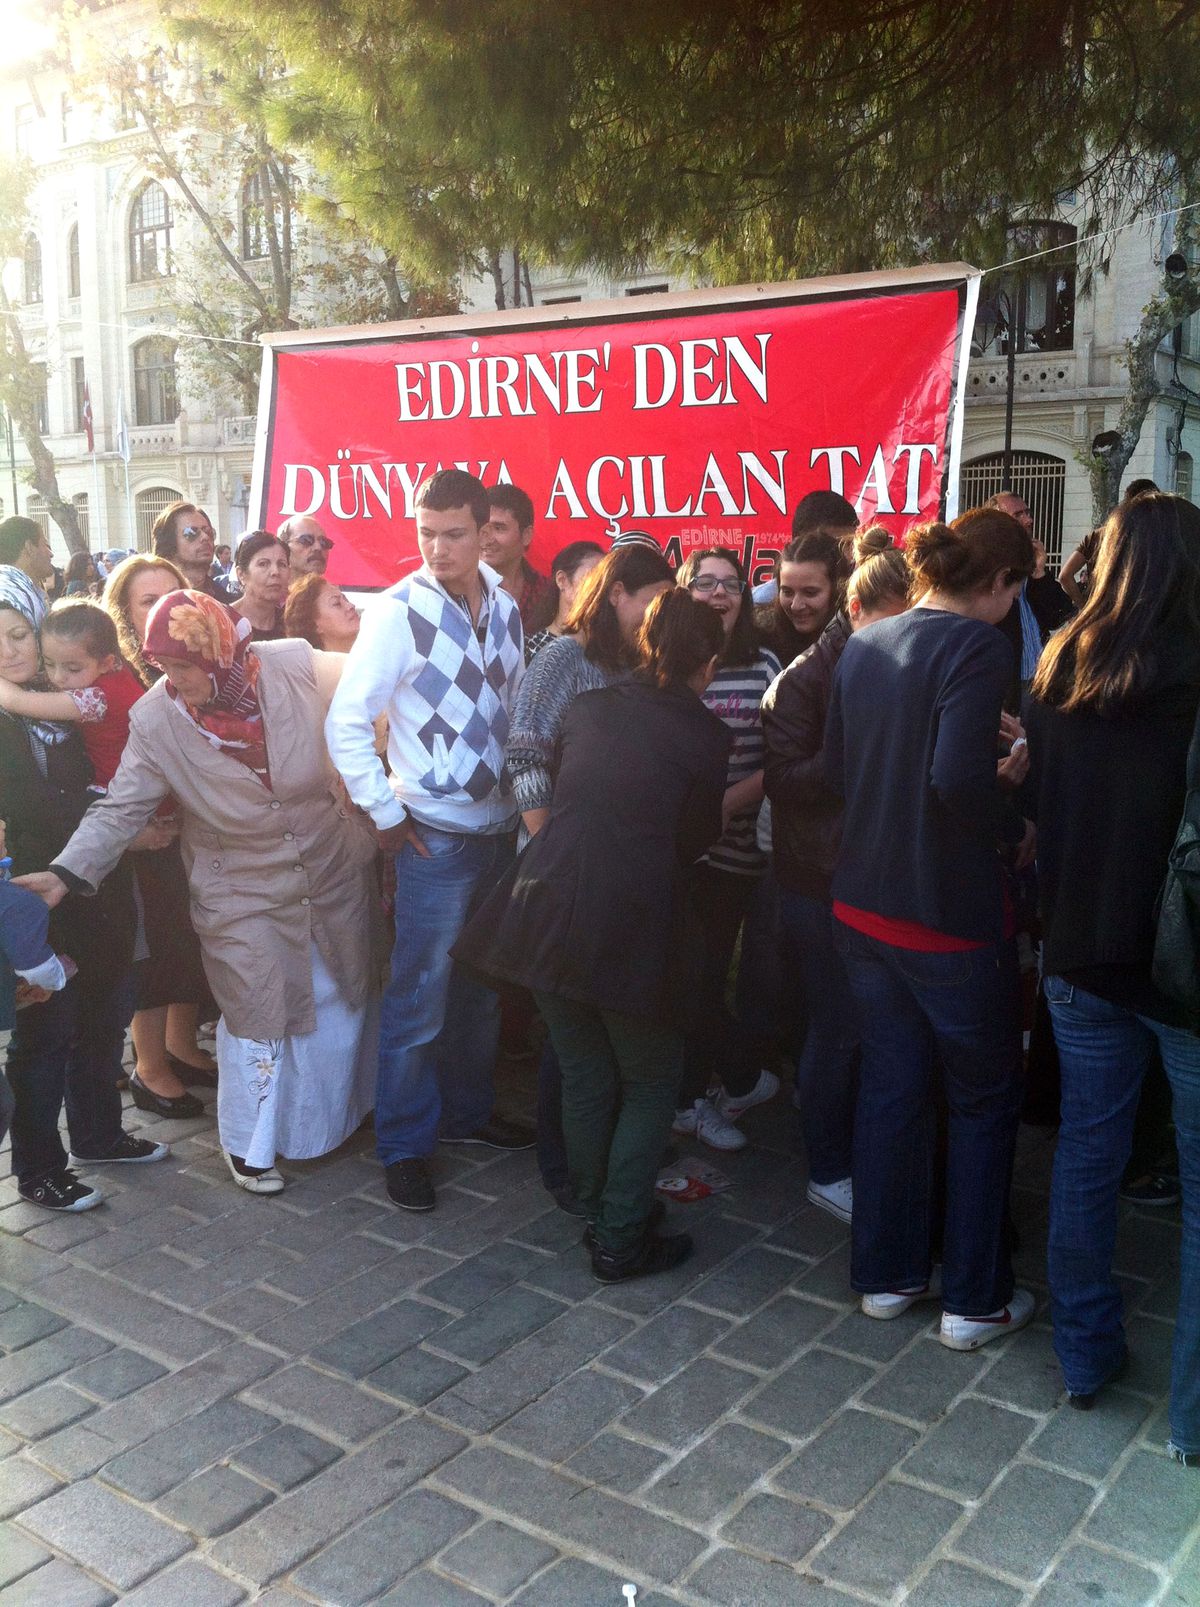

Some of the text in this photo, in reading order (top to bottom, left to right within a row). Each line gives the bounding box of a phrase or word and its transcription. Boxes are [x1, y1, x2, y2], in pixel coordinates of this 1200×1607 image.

[394, 333, 773, 422] EDİRNE' DEN
[544, 451, 789, 538] AÇILAN
[809, 442, 939, 515] TAT
[681, 524, 743, 546] EDİRNE
